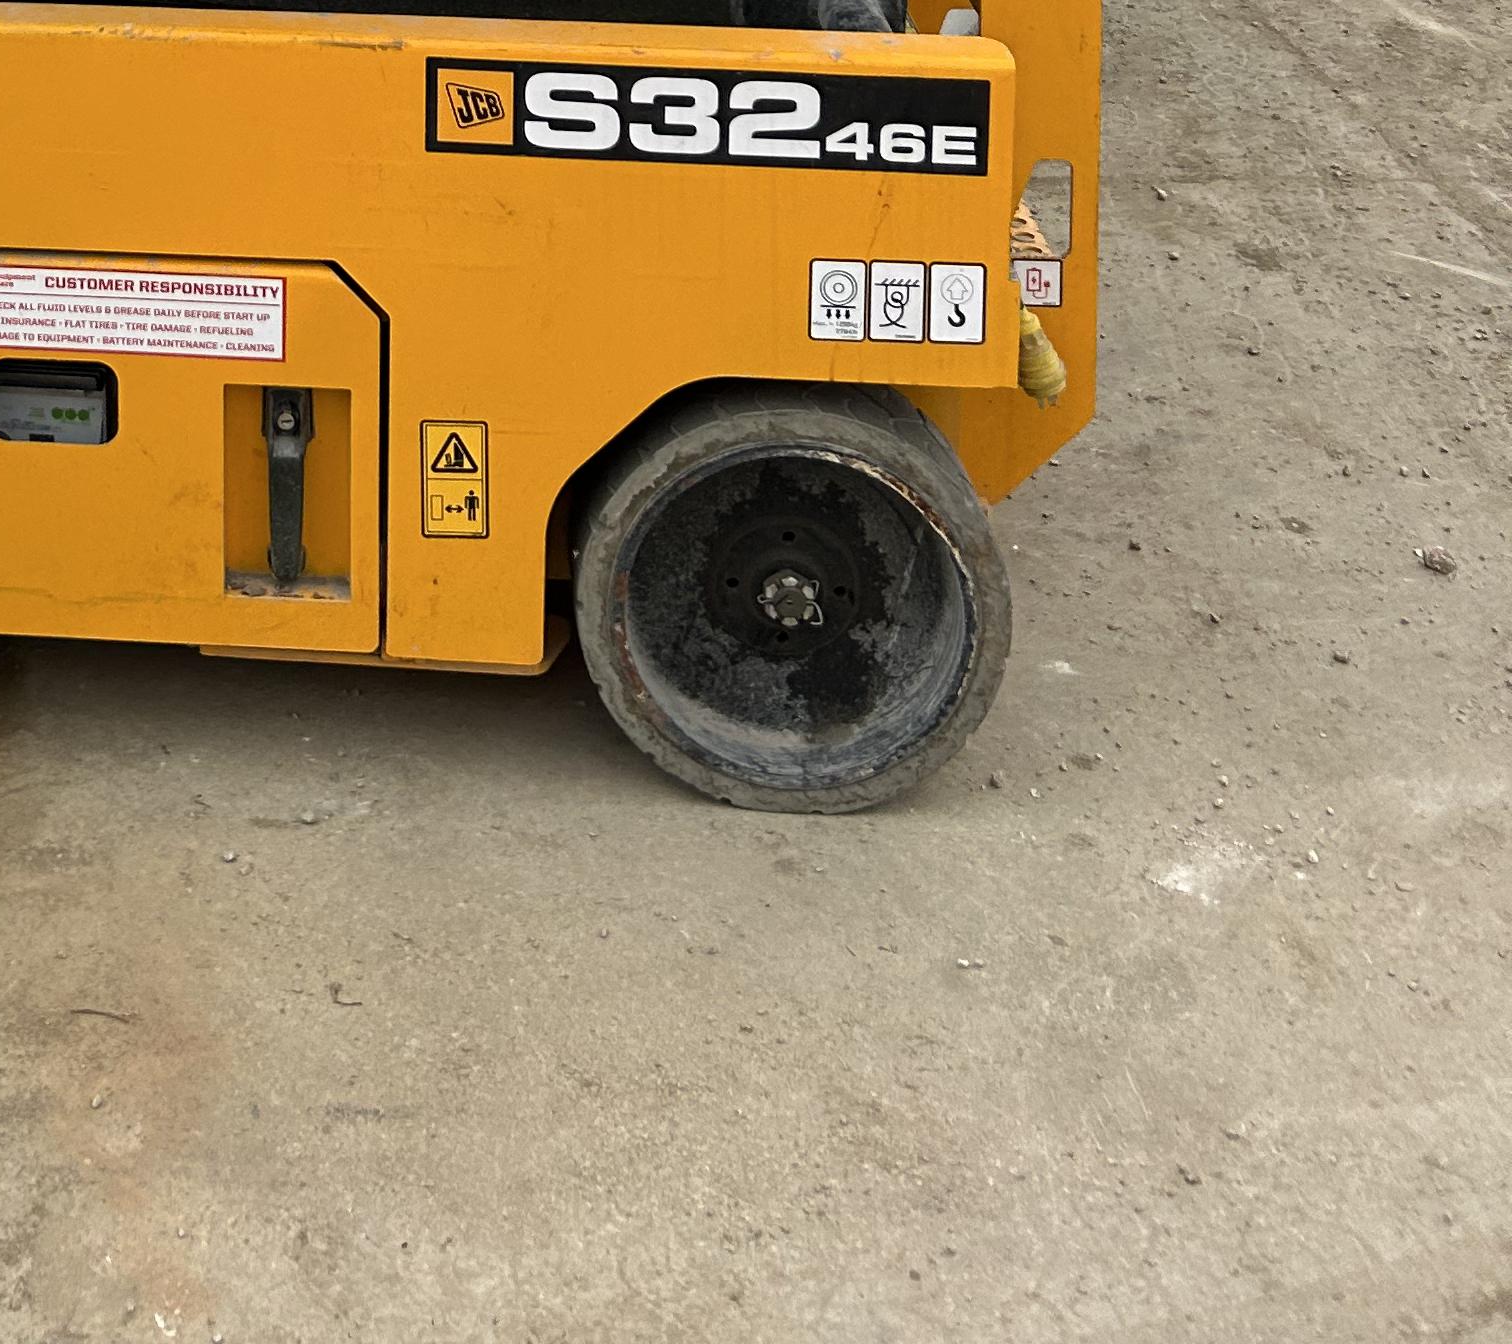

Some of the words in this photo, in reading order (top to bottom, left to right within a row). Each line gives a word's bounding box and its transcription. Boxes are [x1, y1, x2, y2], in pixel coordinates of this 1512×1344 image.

[455, 86, 503, 124] JCB
[45, 276, 135, 292] CUSTOMER
[139, 280, 280, 299] RESPONSIBILITY
[18, 303, 35, 311] ALL
[37, 303, 66, 312] FLUID
[68, 304, 102, 313] LEVELS
[114, 306, 151, 316] GREASE
[154, 308, 182, 317] DAILY
[184, 310, 221, 319] BEFORE
[224, 311, 253, 321] START
[257, 313, 270, 321] UP
[1, 317, 56, 327] INSURANCE
[64, 319, 86, 328] FLAT
[89, 320, 117, 330] TIRES
[125, 322, 148, 331] TIRE
[151, 323, 191, 333] DAMAGE
[199, 326, 254, 336] REFUELING
[23, 332, 35, 341] TO
[37, 333, 94, 345] EQUIPMENT
[102, 336, 144, 346] BATTERY
[147, 338, 218, 349] MAINTENANCE
[226, 342, 275, 352] CLEANING
